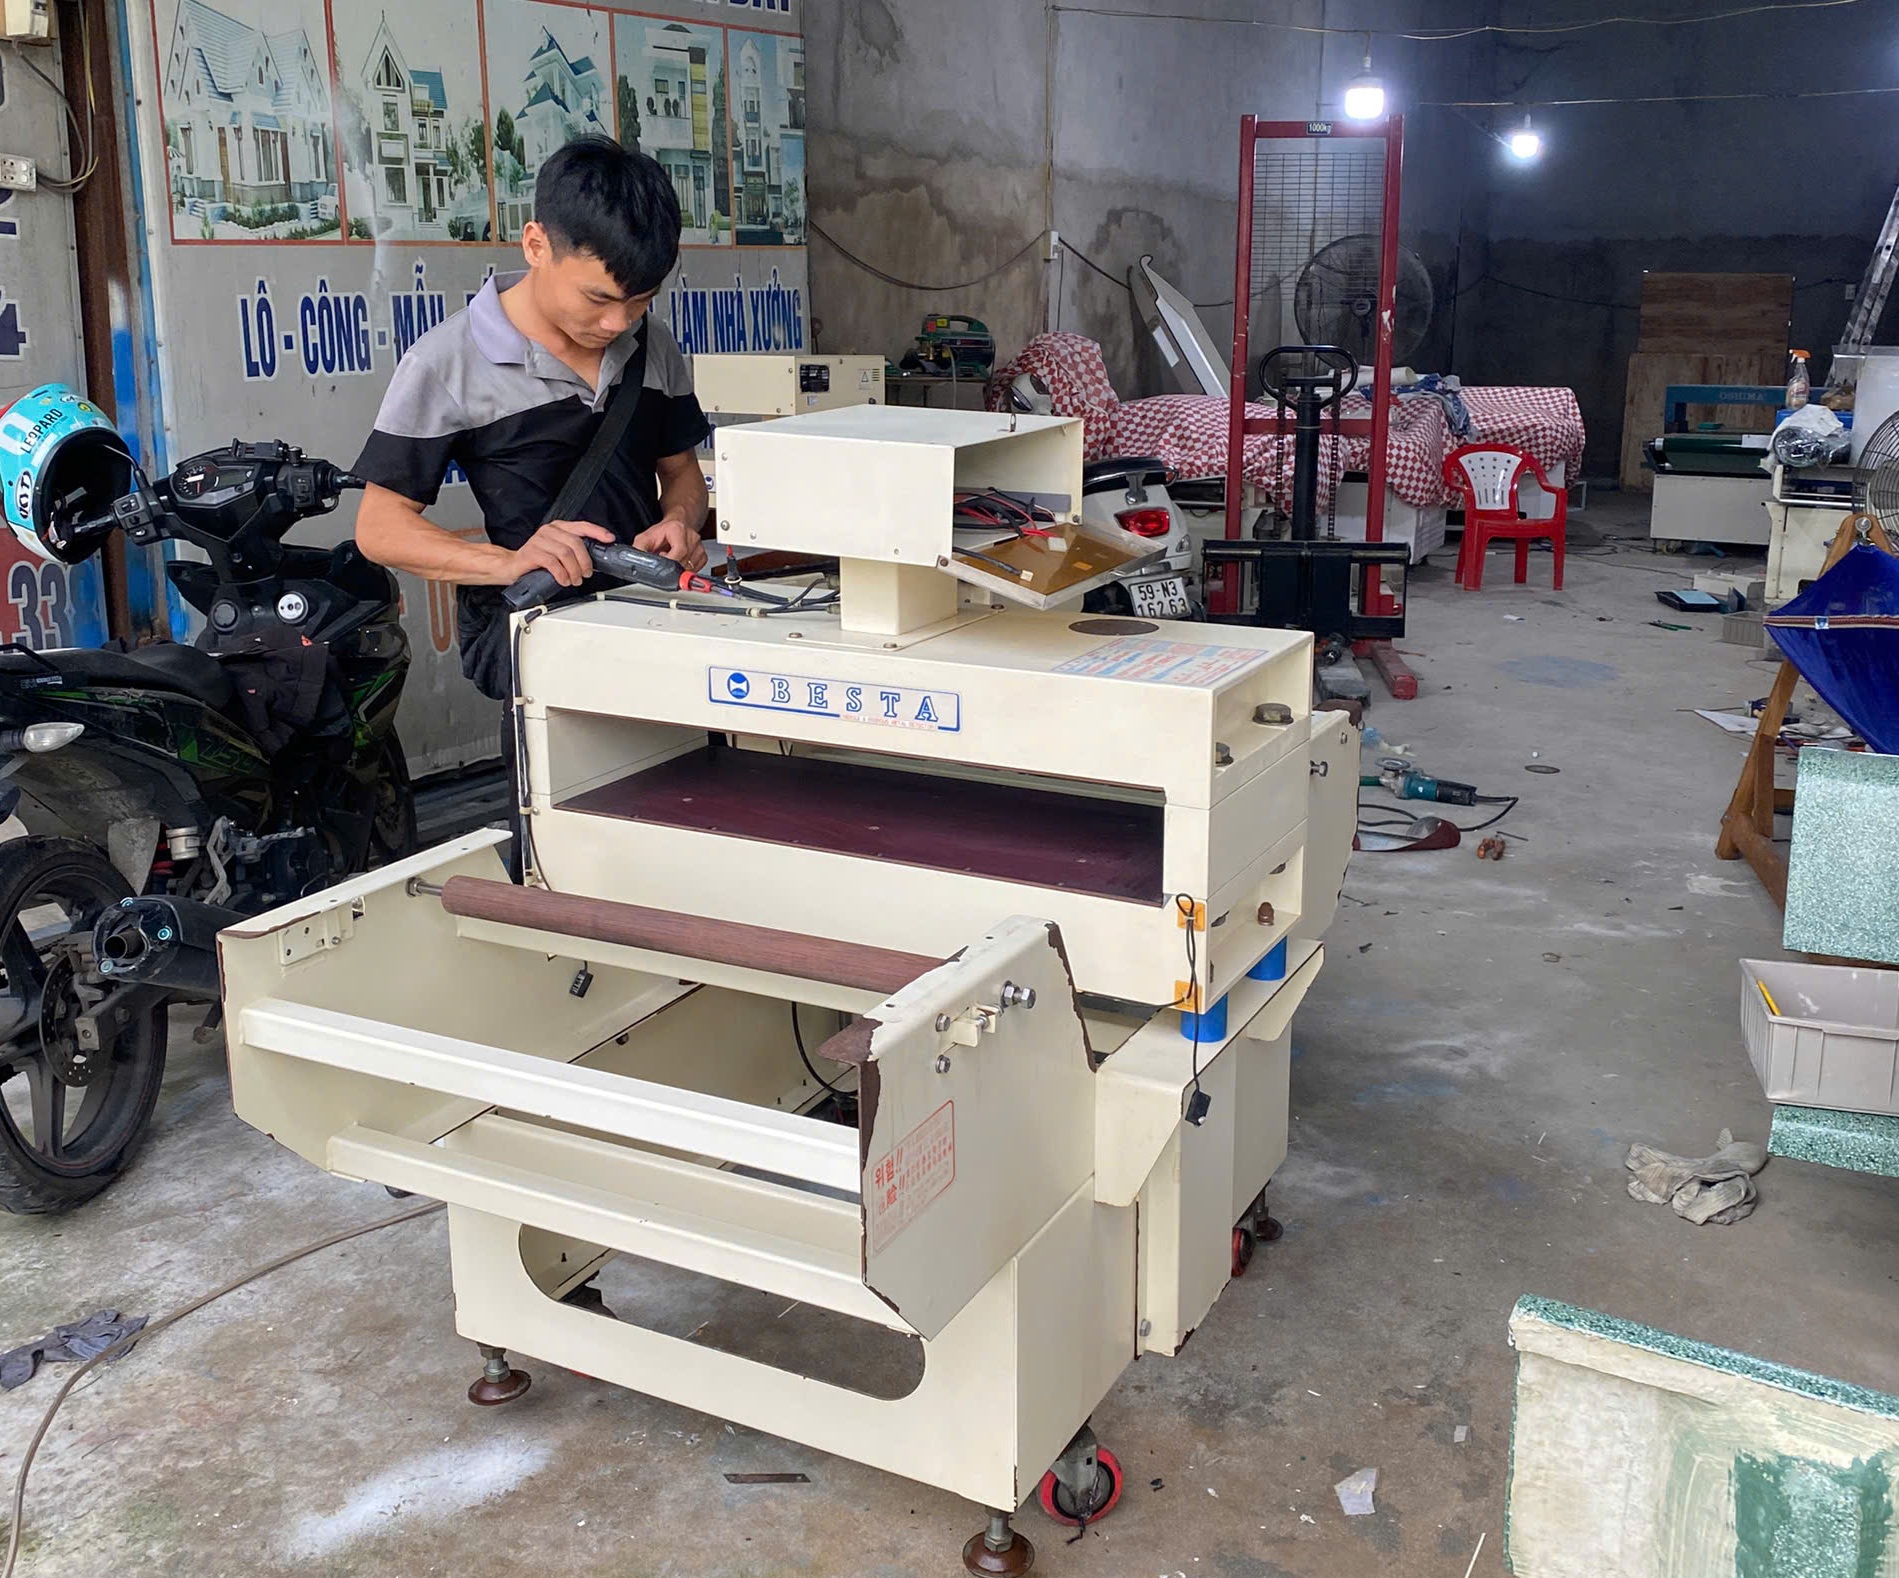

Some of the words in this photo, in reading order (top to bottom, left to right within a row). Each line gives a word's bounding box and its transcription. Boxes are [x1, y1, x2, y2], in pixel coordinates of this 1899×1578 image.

[239, 279, 277, 377] LÔ
[300, 278, 372, 375] CÔNG
[670, 276, 709, 355] LÀM
[712, 276, 748, 353] NHÀ
[750, 268, 803, 352] XƯỞNG
[20, 408, 63, 454] LEOPARD
[1138, 580, 1178, 601] 59-N3
[771, 677, 939, 723] BESTA
